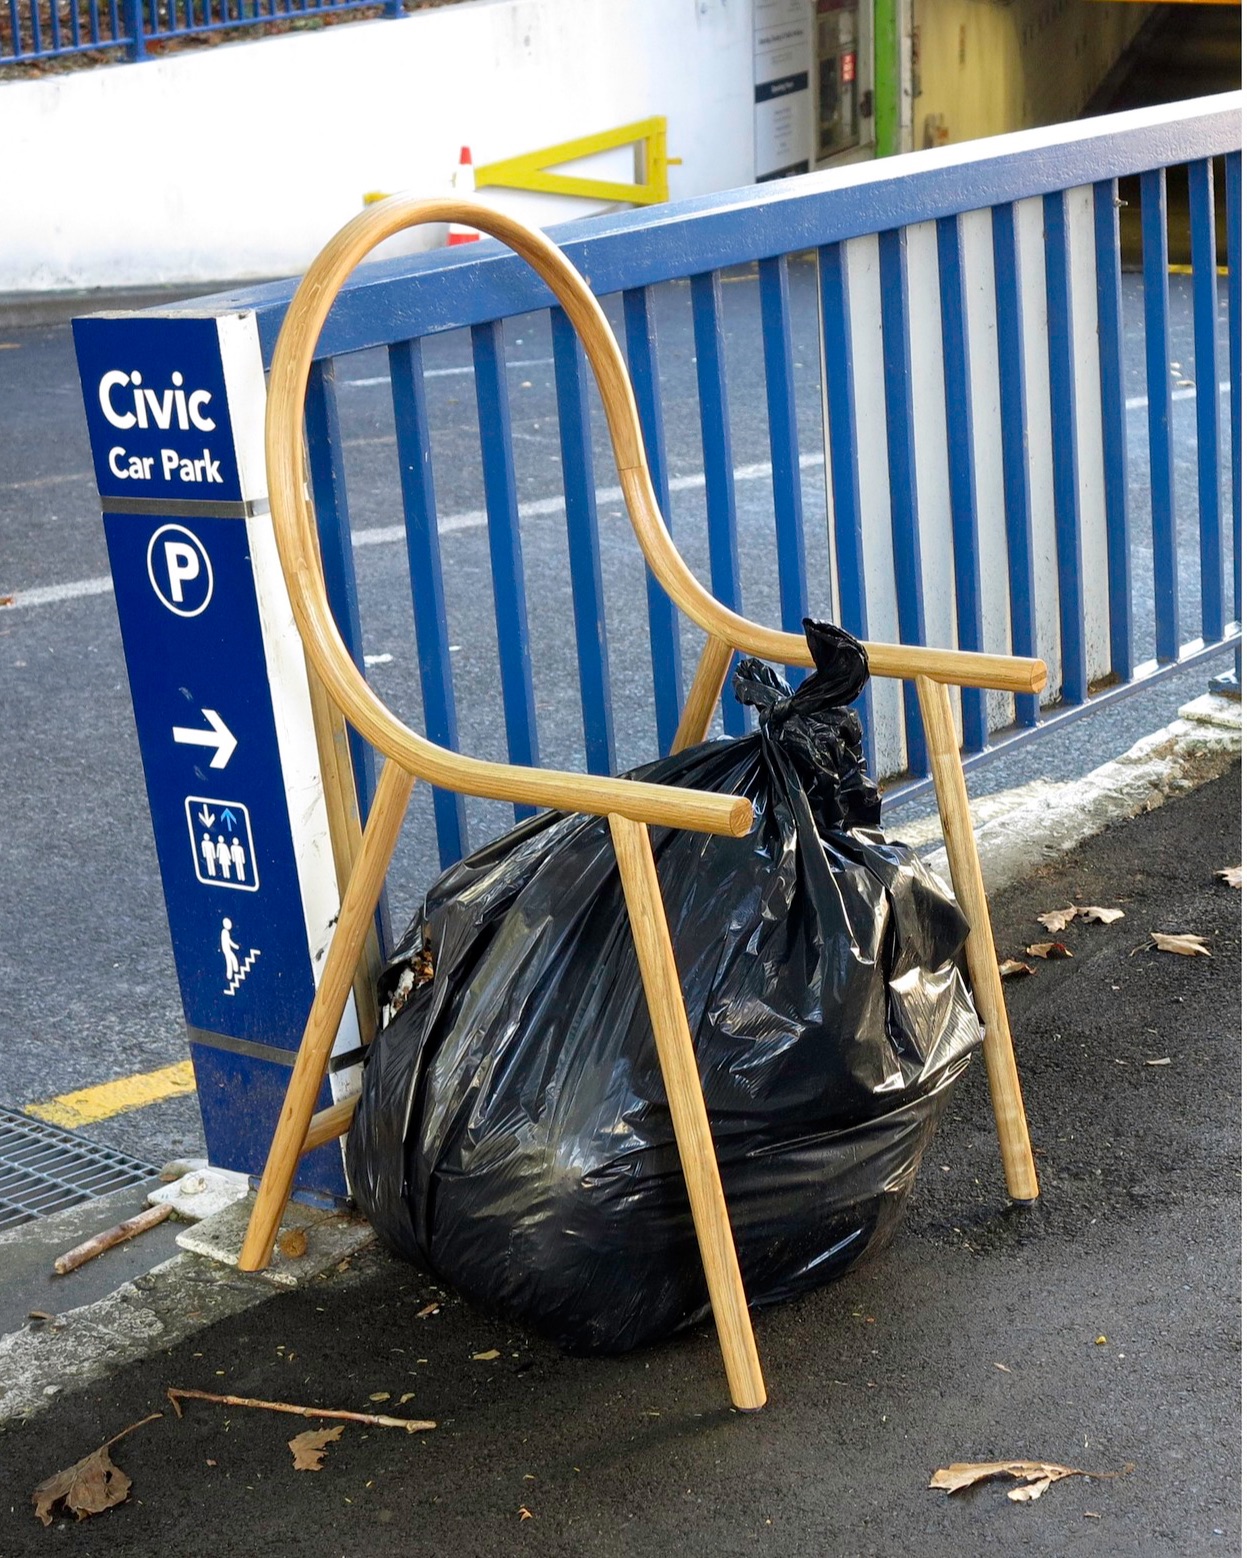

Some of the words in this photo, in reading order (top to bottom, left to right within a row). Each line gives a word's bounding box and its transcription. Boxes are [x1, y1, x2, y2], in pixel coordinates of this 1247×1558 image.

[98, 370, 217, 432] Civic
[108, 446, 155, 480] Car
[160, 448, 224, 483] Park
[164, 541, 200, 603] P
